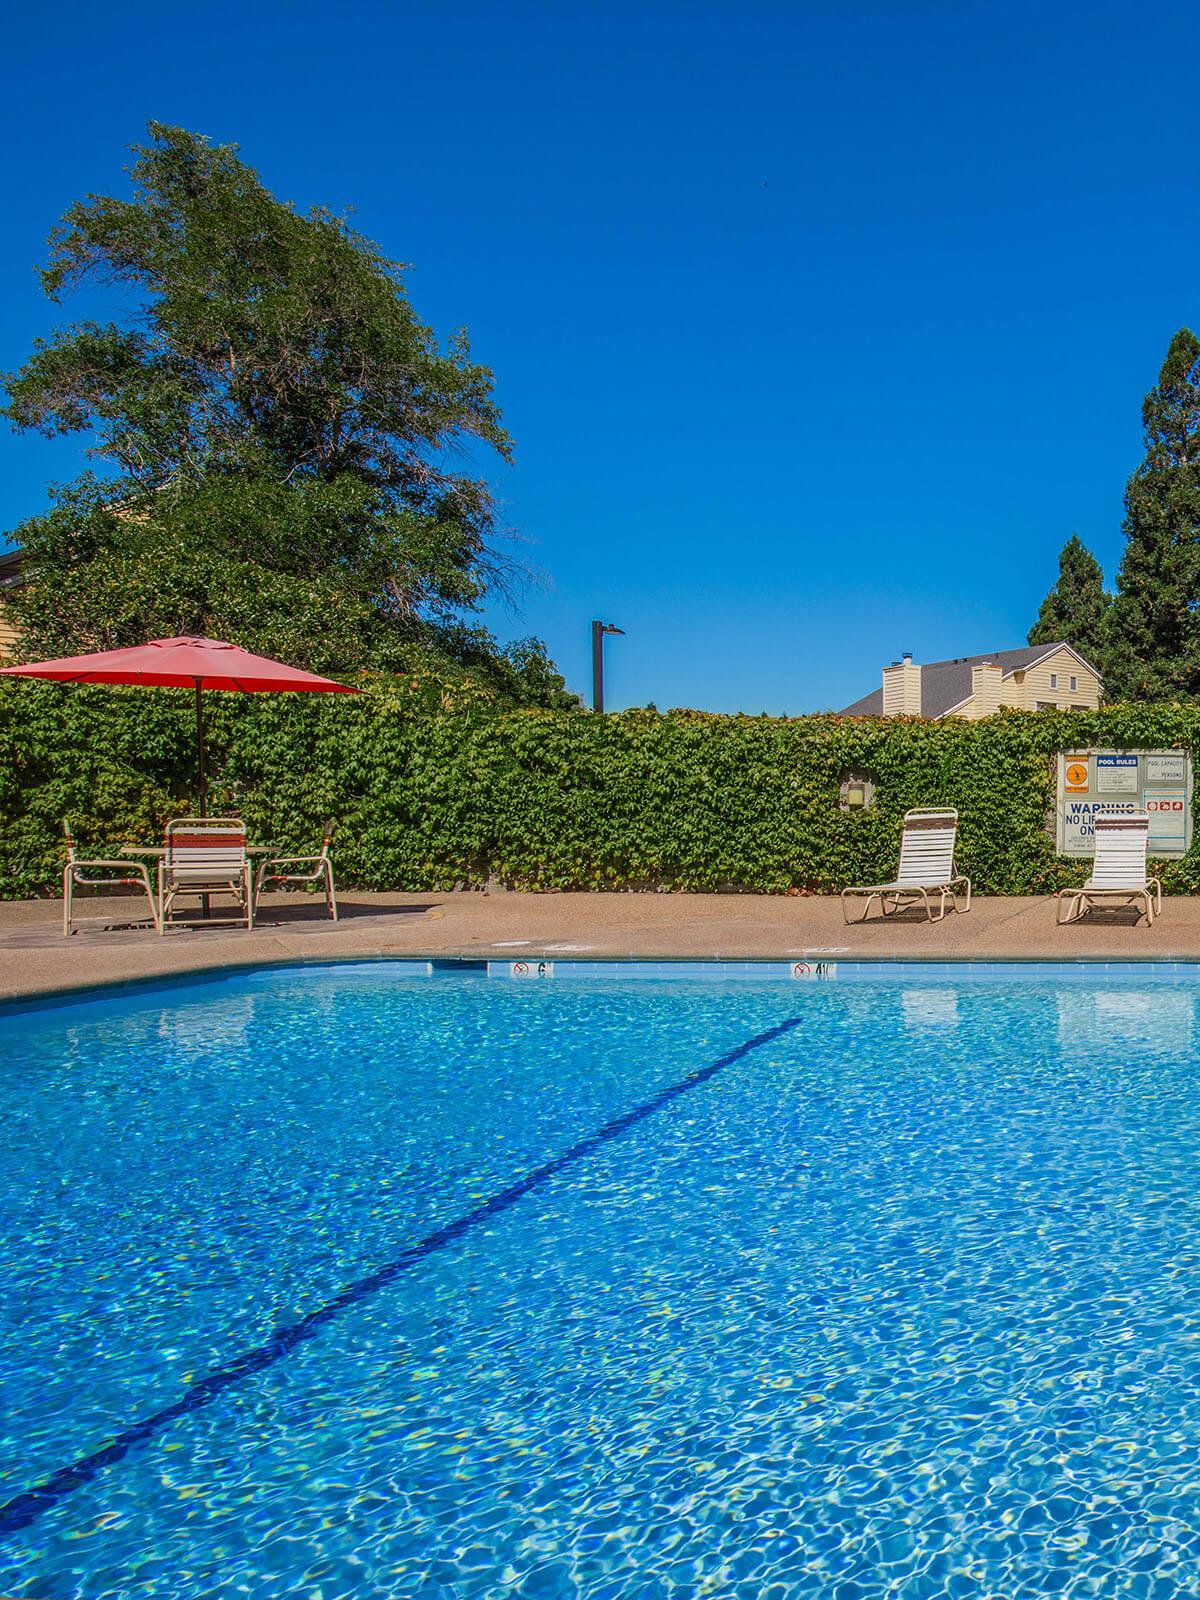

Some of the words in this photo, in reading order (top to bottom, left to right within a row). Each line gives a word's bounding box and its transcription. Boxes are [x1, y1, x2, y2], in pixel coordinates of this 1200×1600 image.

[1070, 803, 1135, 814] WARNING
[1065, 814, 1080, 825] NO
[1079, 825, 1095, 836] ON
